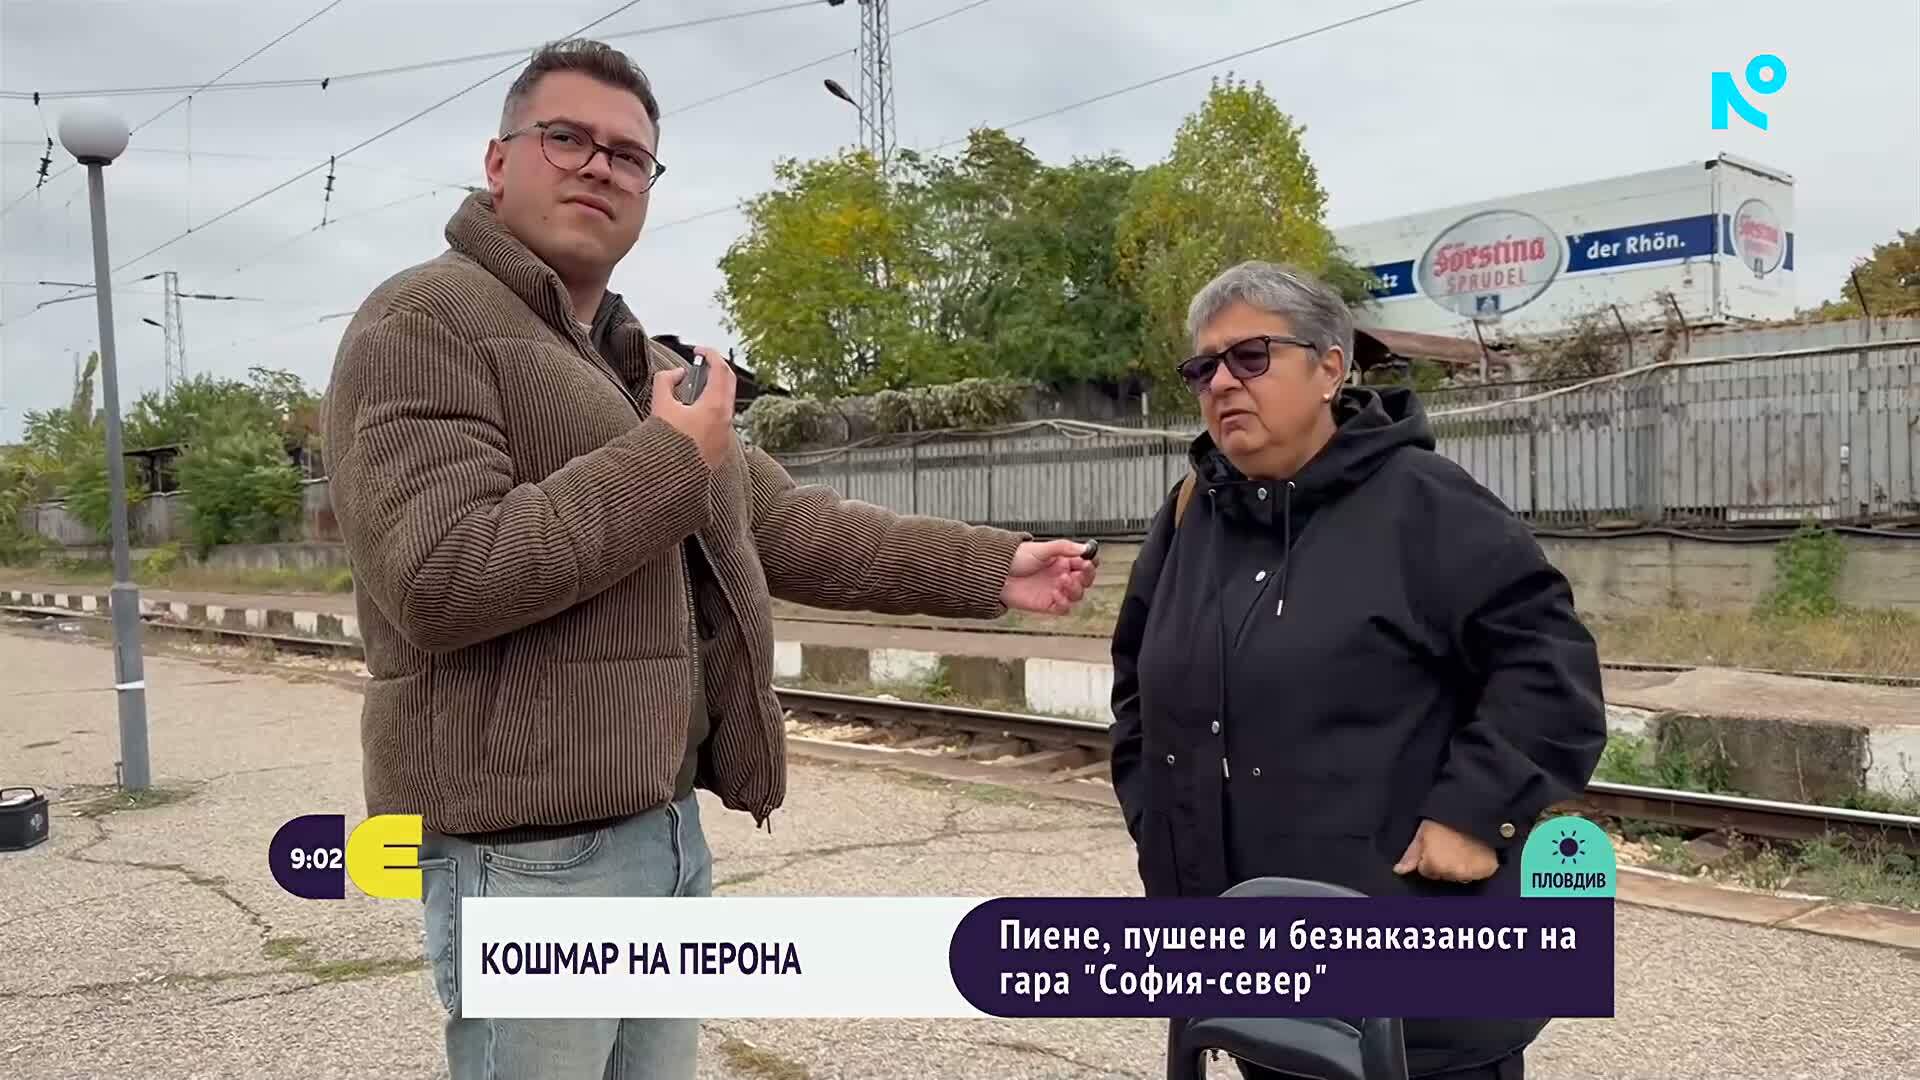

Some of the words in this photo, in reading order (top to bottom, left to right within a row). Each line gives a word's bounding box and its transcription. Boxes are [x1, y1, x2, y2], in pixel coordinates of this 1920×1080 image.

[1586, 240, 1620, 259] der
[1626, 231, 1685, 254] Rhön.
[1447, 267, 1526, 294] SPRUDEL
